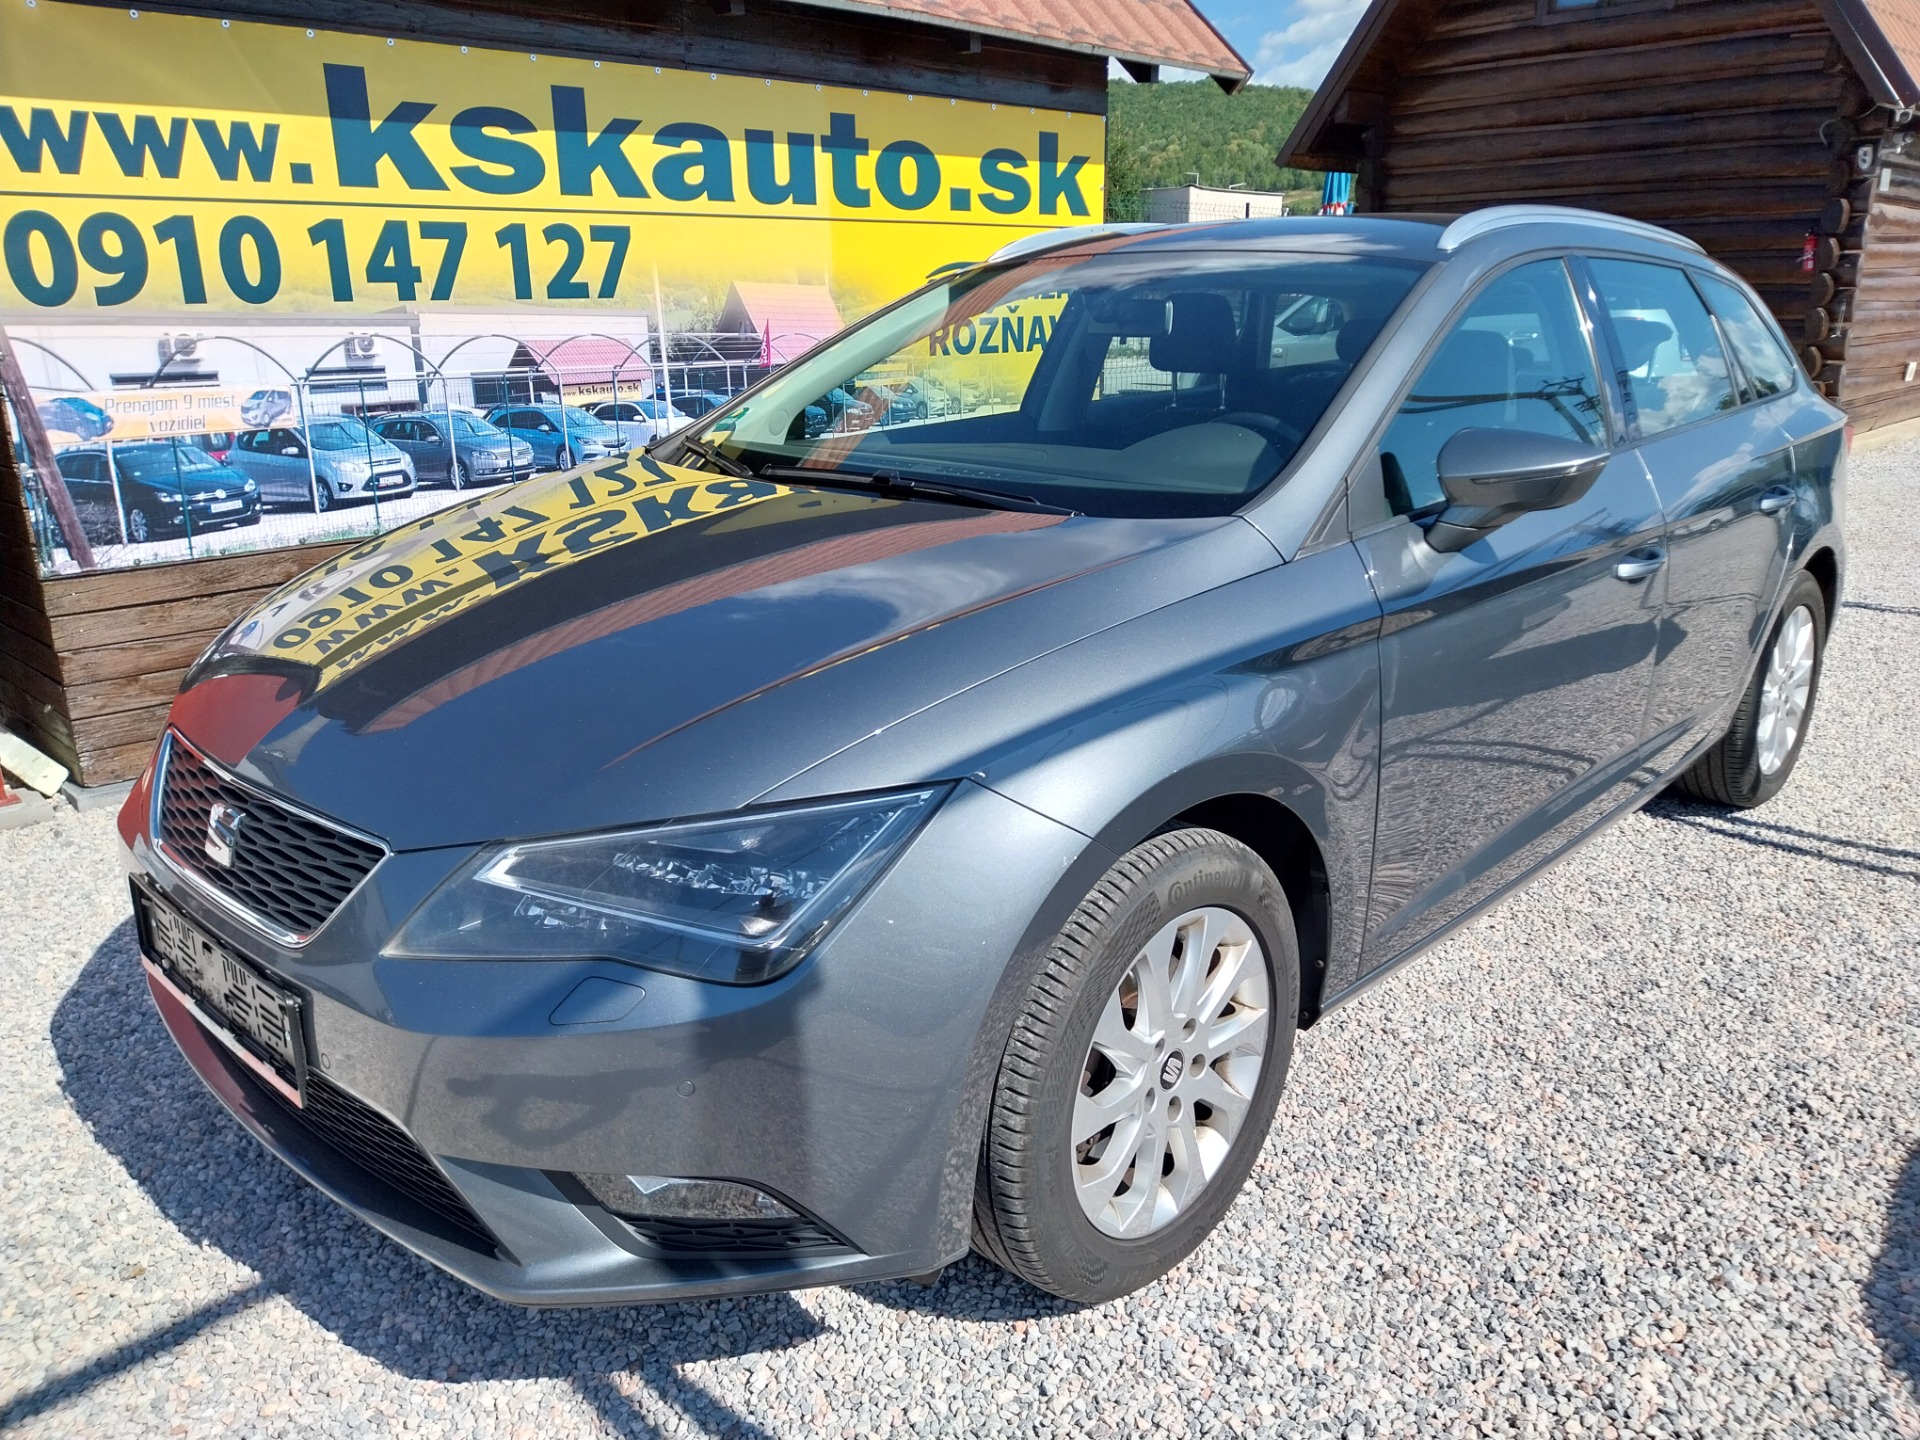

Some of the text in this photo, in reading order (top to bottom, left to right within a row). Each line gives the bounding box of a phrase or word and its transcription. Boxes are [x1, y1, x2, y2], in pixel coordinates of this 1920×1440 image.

[0, 63, 1090, 216] www.kskauto.sk
[3, 210, 632, 308] 0910 147 127
[184, 394, 193, 409] 9
[562, 382, 640, 397] www.kskauo.sk
